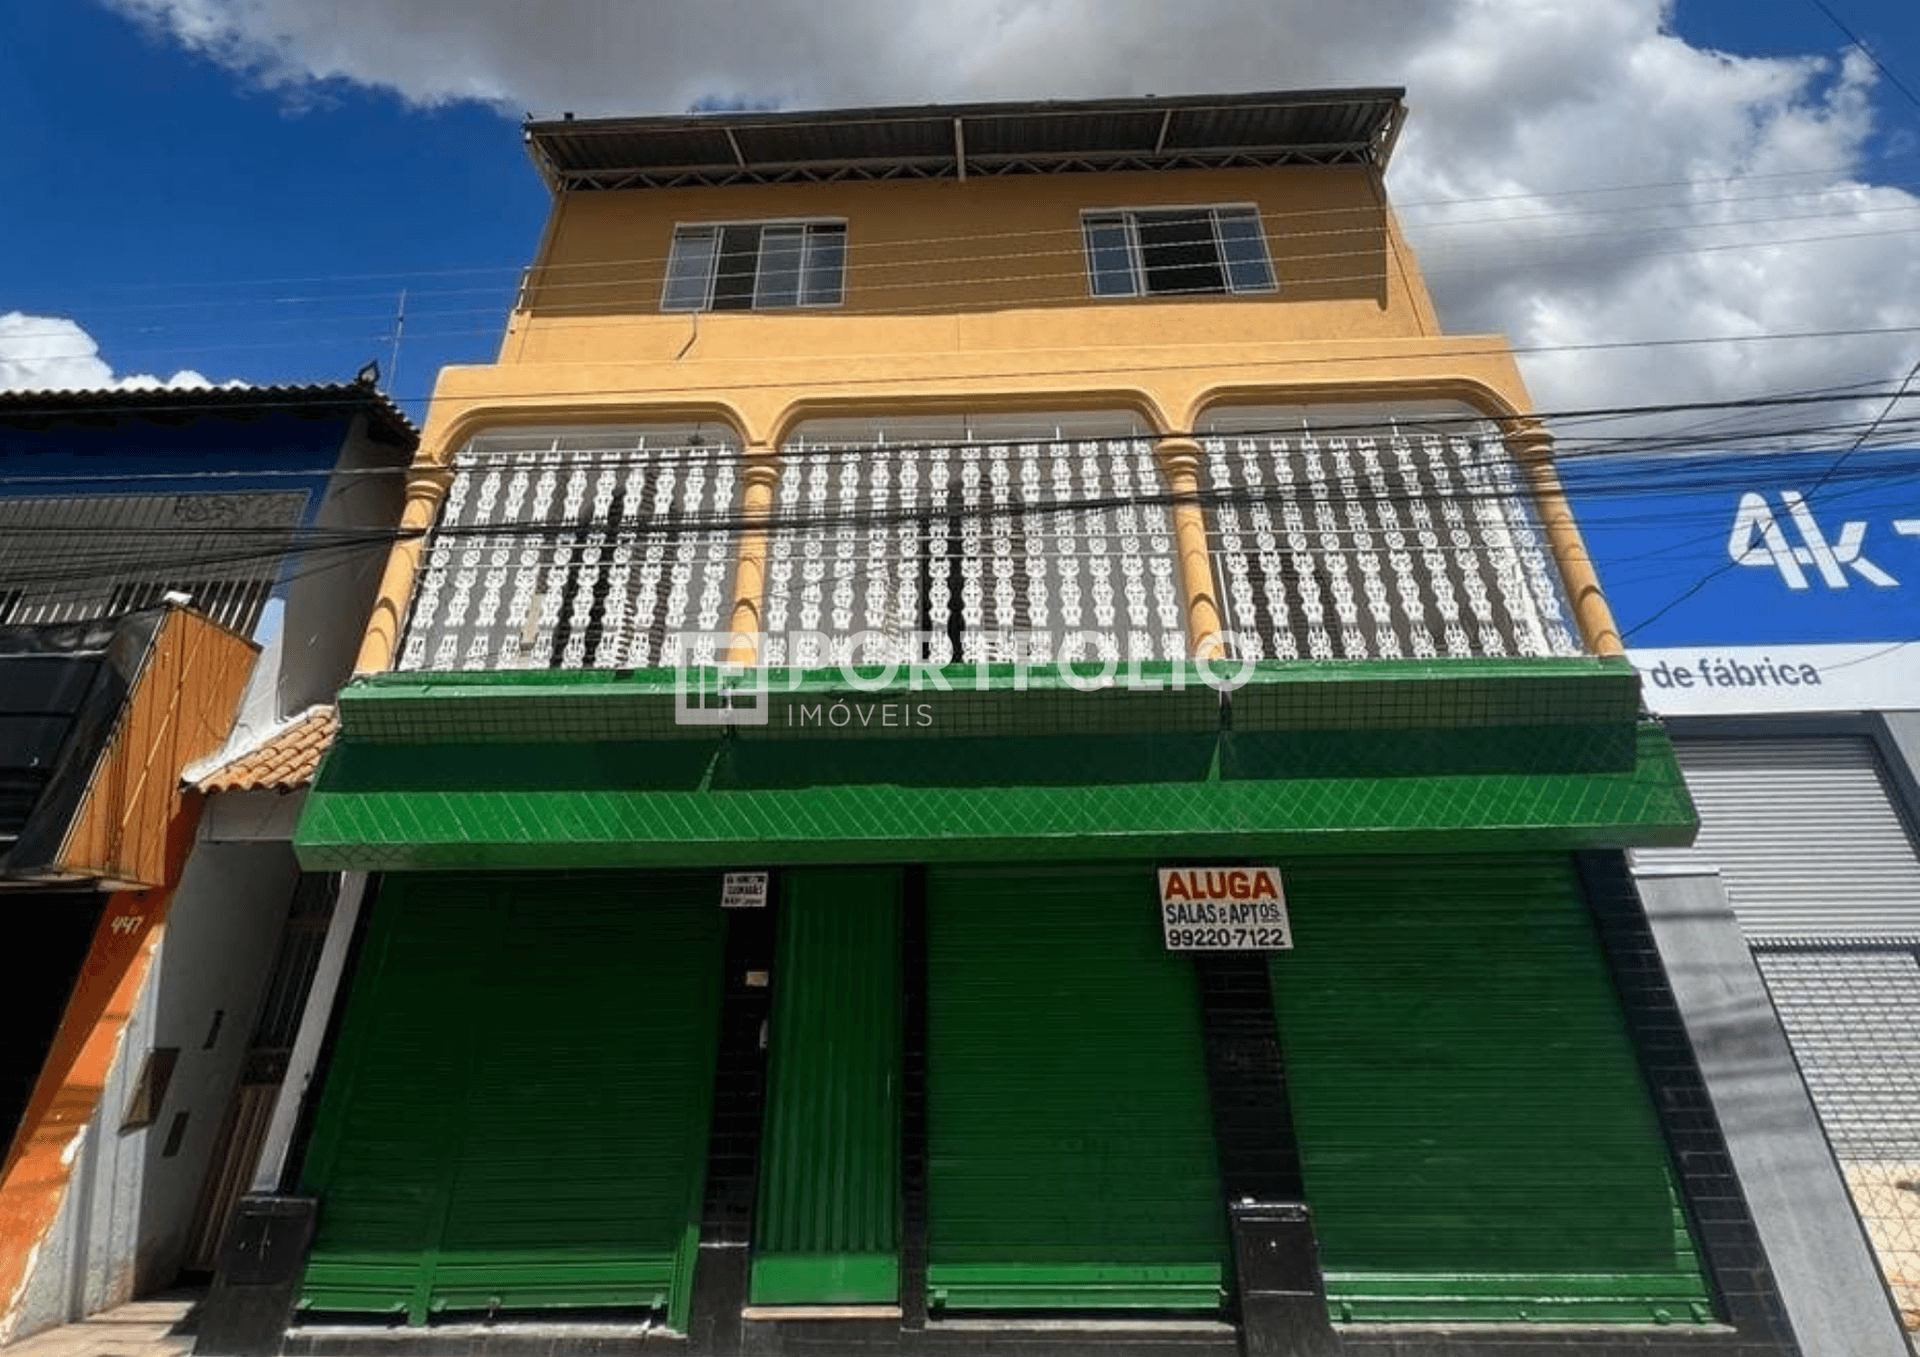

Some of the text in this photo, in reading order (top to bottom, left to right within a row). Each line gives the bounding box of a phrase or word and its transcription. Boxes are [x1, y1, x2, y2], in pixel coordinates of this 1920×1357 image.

[1652, 657, 1822, 688] de fábrica
[1165, 871, 1278, 900] ALUGA
[1165, 904, 1217, 924] SALAS
[1168, 928, 1286, 947] 99220-7122
